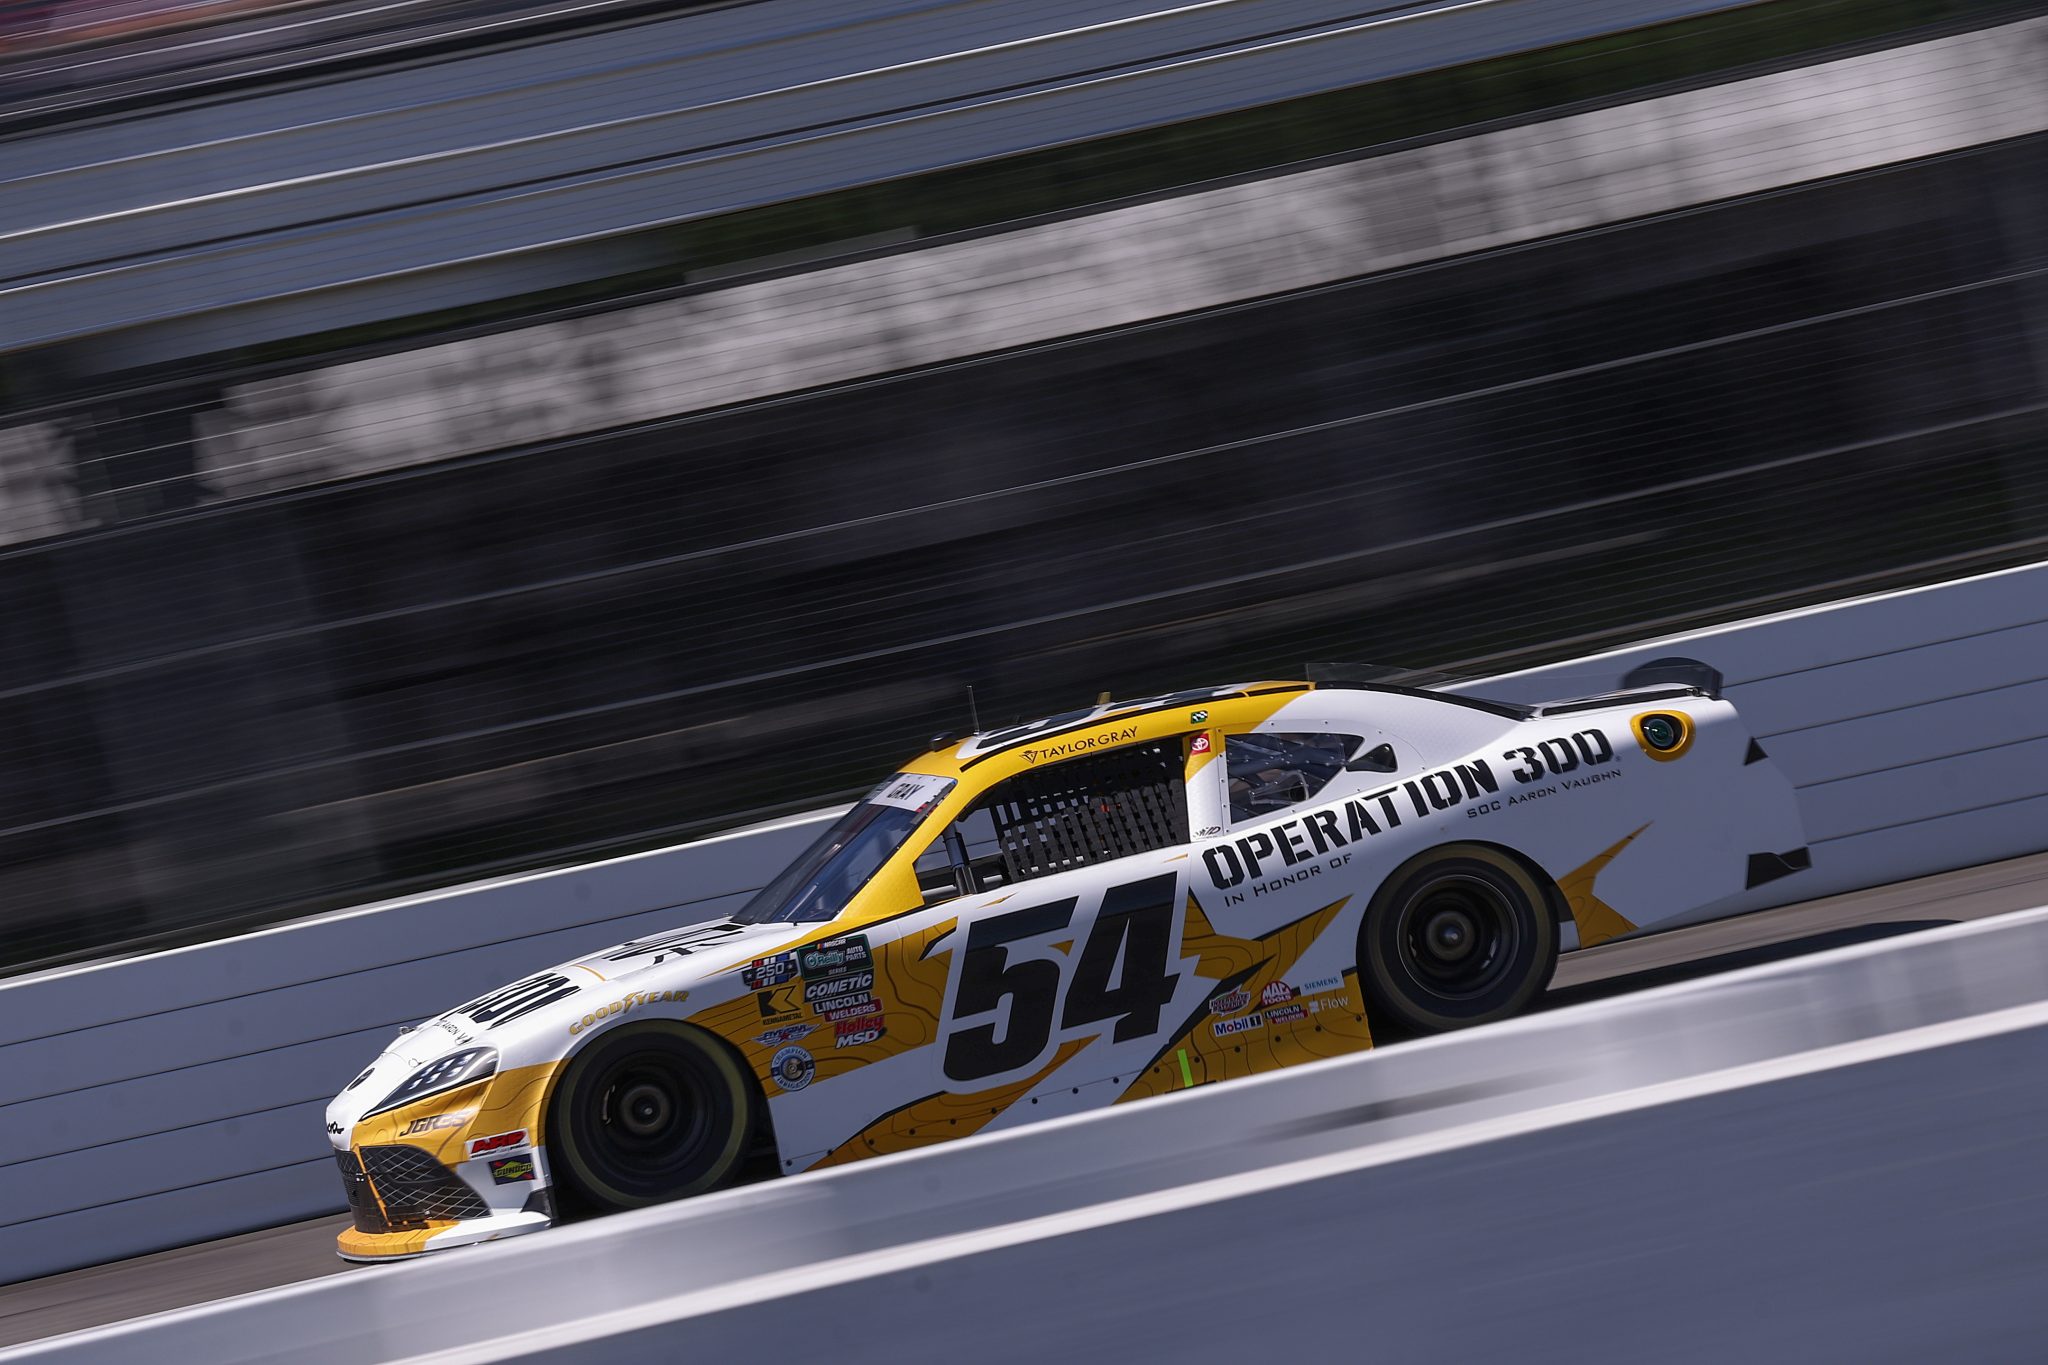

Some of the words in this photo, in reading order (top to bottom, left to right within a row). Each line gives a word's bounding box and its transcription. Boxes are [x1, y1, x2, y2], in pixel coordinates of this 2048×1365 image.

[1040, 737, 1097, 759] TAYLOR
[1098, 726, 1138, 747] GRAY
[1466, 802, 1501, 819] SOC
[1507, 786, 1557, 806] AARON
[1561, 769, 1622, 792] VAUGHN
[1202, 758, 1498, 891] OPERATION
[1503, 728, 1614, 783] 300
[1223, 886, 1251, 908] IN
[1253, 864, 1324, 897] HONOR
[1329, 853, 1353, 874] OF
[823, 938, 847, 948] NASCAR
[846, 945, 864, 955] AUTO
[805, 948, 845, 968] O'Reilly
[845, 952, 867, 962] PARTS
[755, 962, 785, 979] 250
[943, 871, 1181, 1081] 54
[806, 973, 873, 998] COMETIC
[1262, 980, 1288, 998] MAC
[1304, 977, 1339, 991] SIEMENS
[815, 993, 870, 1012] LINCOLN
[1263, 995, 1291, 1006] TOOLS
[1321, 996, 1349, 1012] Flow
[569, 990, 690, 1036] GOODYEAR
[763, 1013, 803, 1025] KENNAMETAL
[830, 1004, 876, 1019] WELDERS
[1266, 1005, 1301, 1019] LINCOLN
[1275, 1012, 1305, 1024] WELDERS
[835, 1015, 885, 1035] Holley
[1215, 1018, 1249, 1036] Mobil
[835, 1029, 880, 1048] MSD
[470, 1130, 527, 1153] ARP
[495, 1163, 532, 1178] SUNOCO
